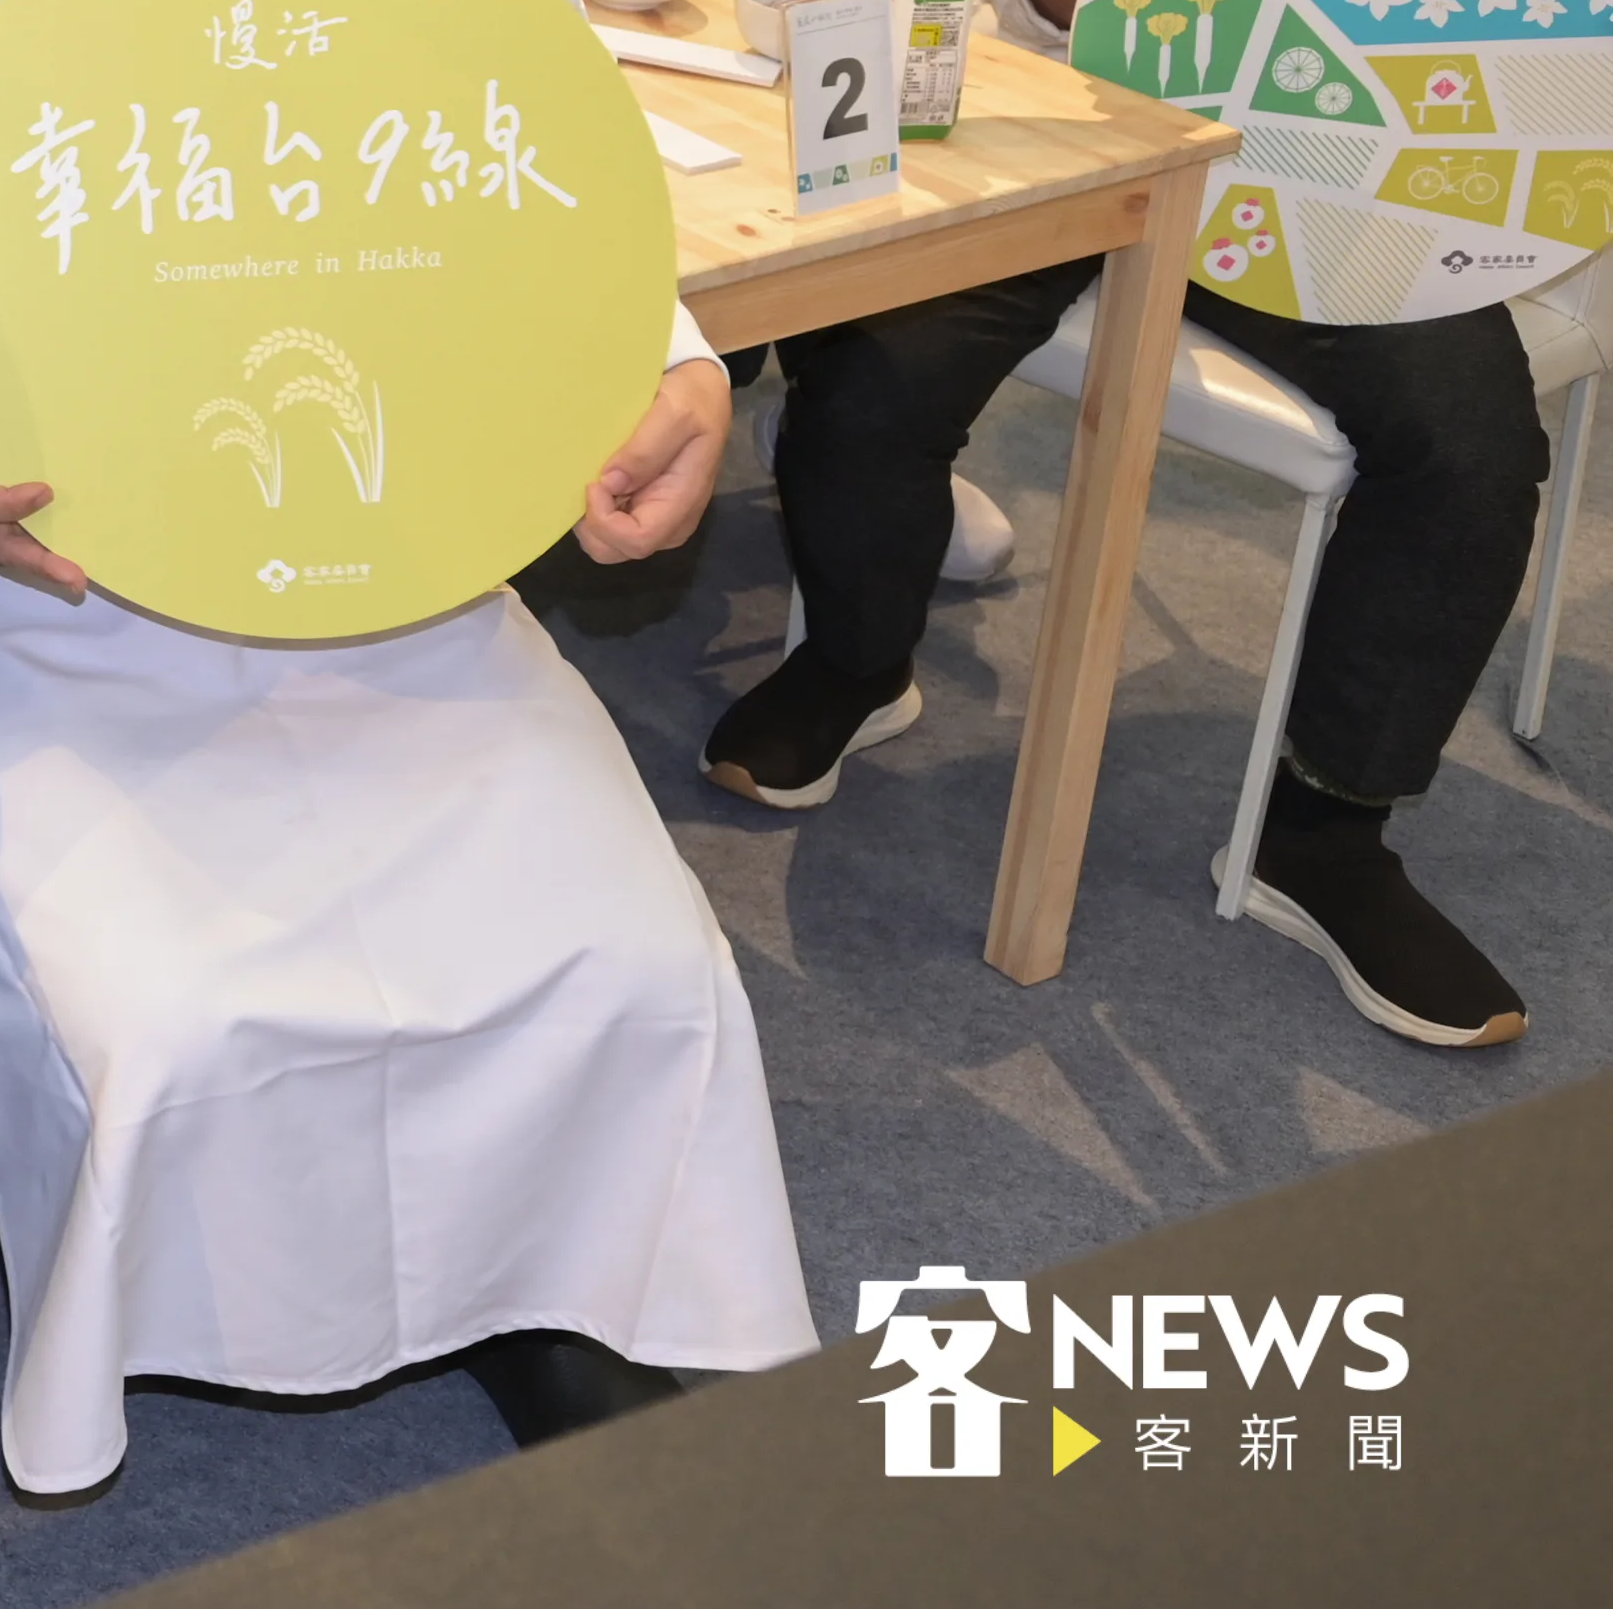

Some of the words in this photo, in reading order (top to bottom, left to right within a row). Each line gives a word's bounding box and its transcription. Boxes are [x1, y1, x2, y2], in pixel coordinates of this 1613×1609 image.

[821, 57, 869, 141] 2
[10, 78, 578, 276] 幸福台9線
[153, 253, 300, 284] Somewhere
[316, 252, 341, 275] in
[357, 246, 443, 272] Hakka
